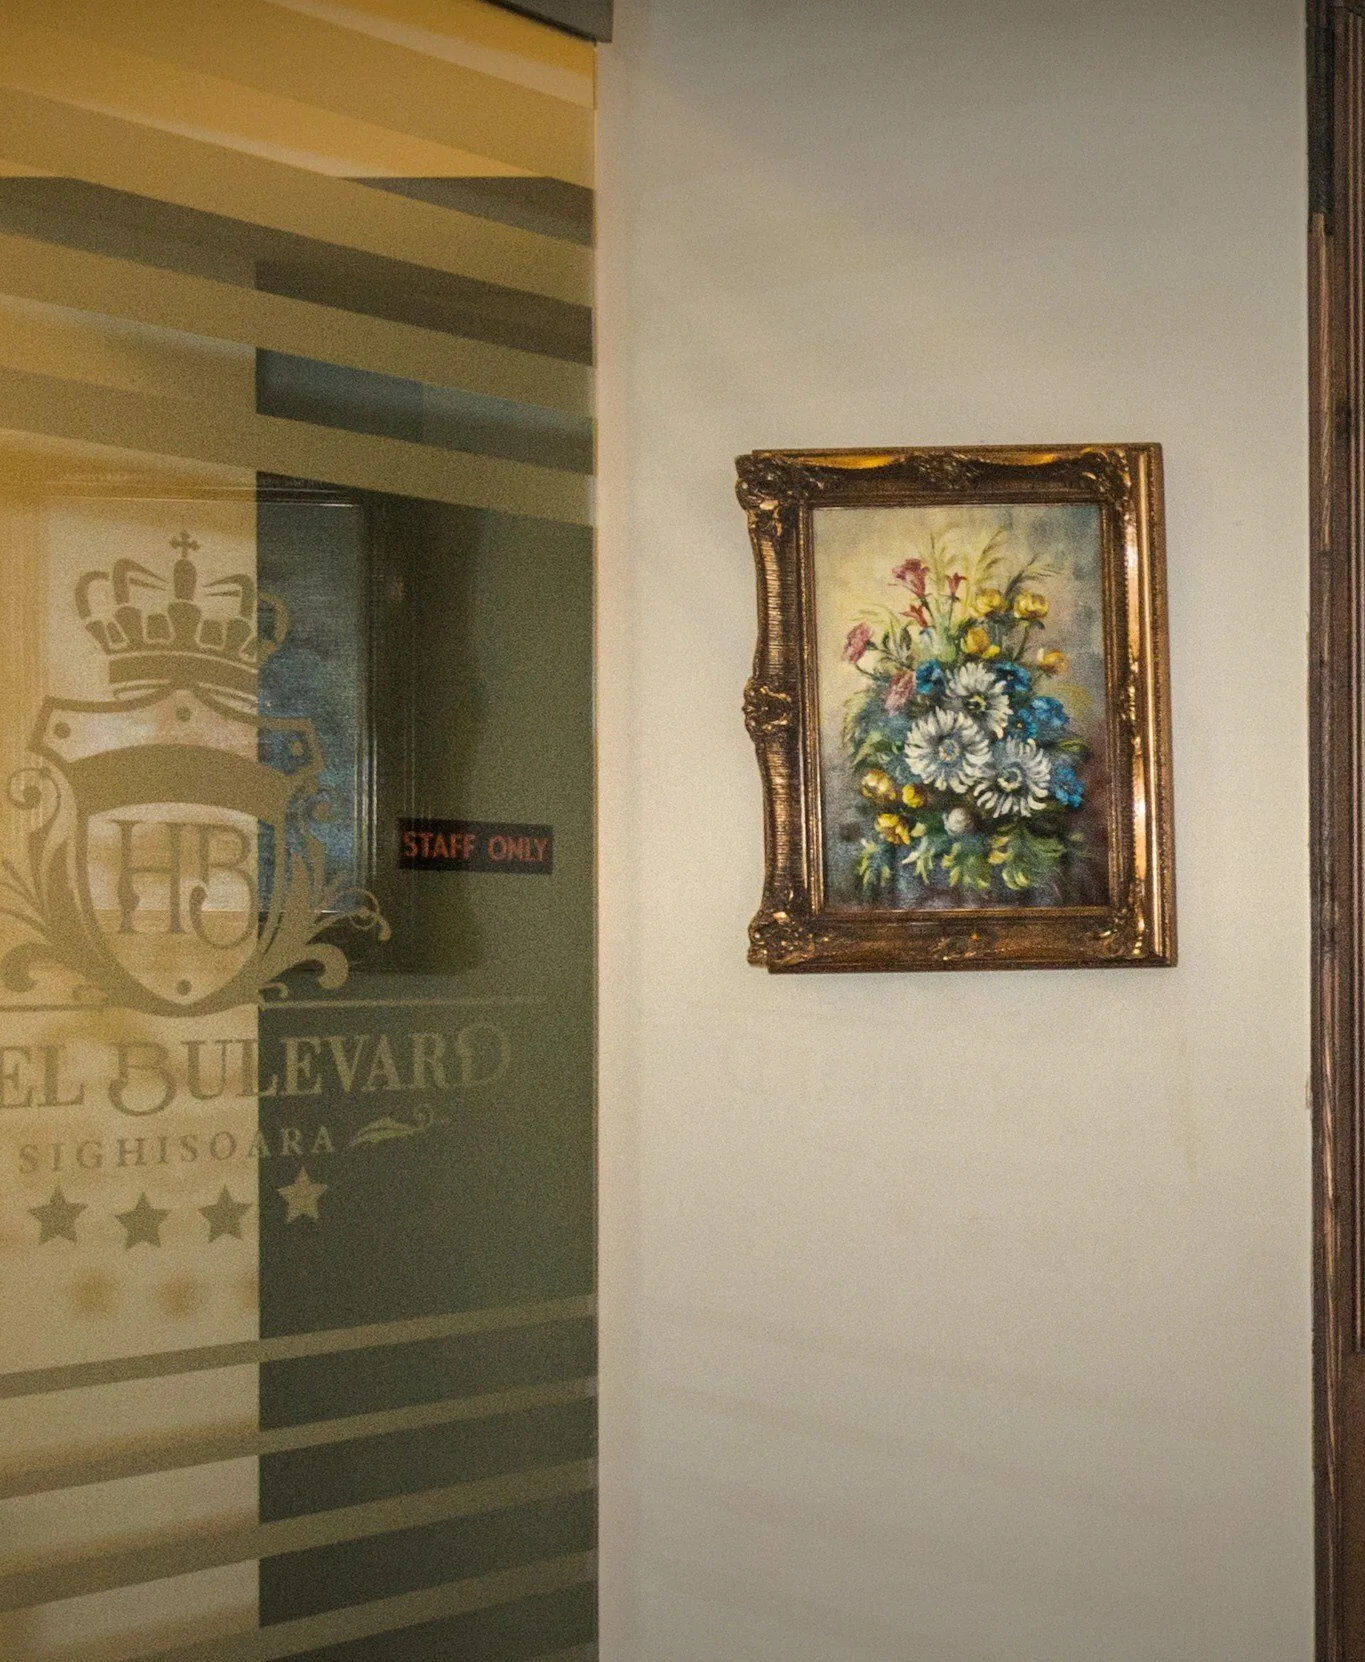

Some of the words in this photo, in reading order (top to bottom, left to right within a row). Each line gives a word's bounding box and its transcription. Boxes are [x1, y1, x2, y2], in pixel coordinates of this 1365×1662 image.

[403, 830, 475, 860] STAFF
[487, 835, 549, 862] ONLY
[106, 1020, 512, 1118] BULEVARD
[18, 1123, 337, 1176] SIGHISOARA
